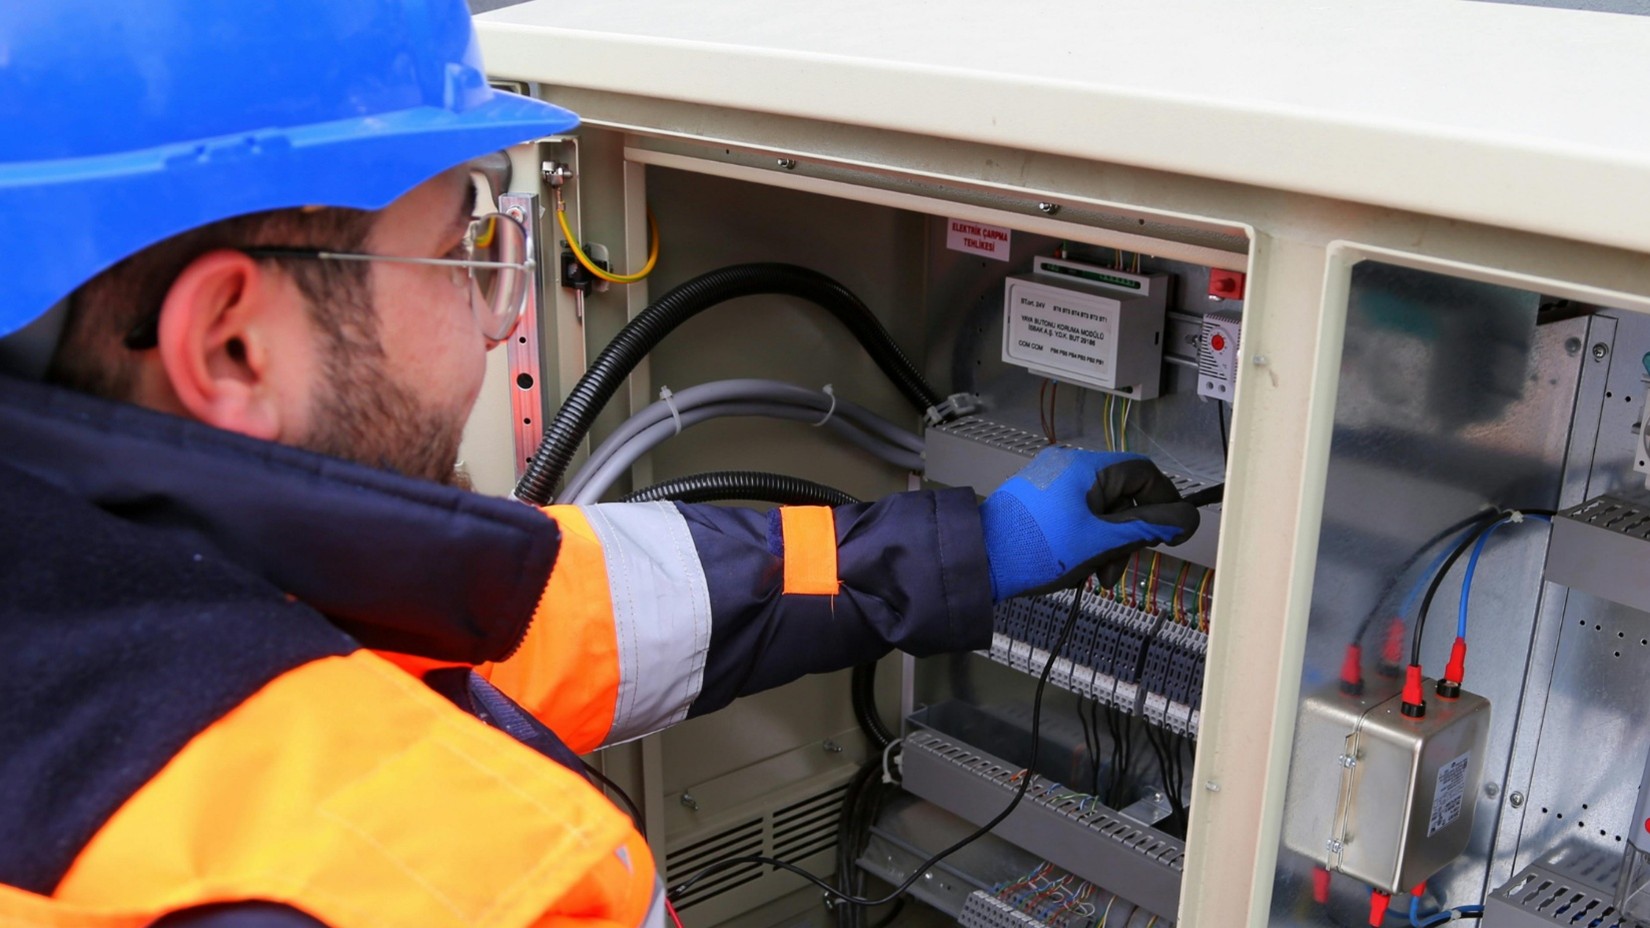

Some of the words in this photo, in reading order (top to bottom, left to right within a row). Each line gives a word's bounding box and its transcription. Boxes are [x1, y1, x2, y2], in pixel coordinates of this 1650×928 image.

[952, 222, 981, 235] ELEKTRİK
[983, 228, 1007, 242] ÇARPMA
[964, 237, 994, 252] TEHLİKESİ
[1034, 318, 1055, 328] BUTONU
[1057, 323, 1080, 334] KORUMA
[1081, 328, 1104, 340] MODÜLÜ
[1019, 340, 1030, 348] COM
[1031, 343, 1043, 351] COM
[1069, 334, 1080, 342] BUT
